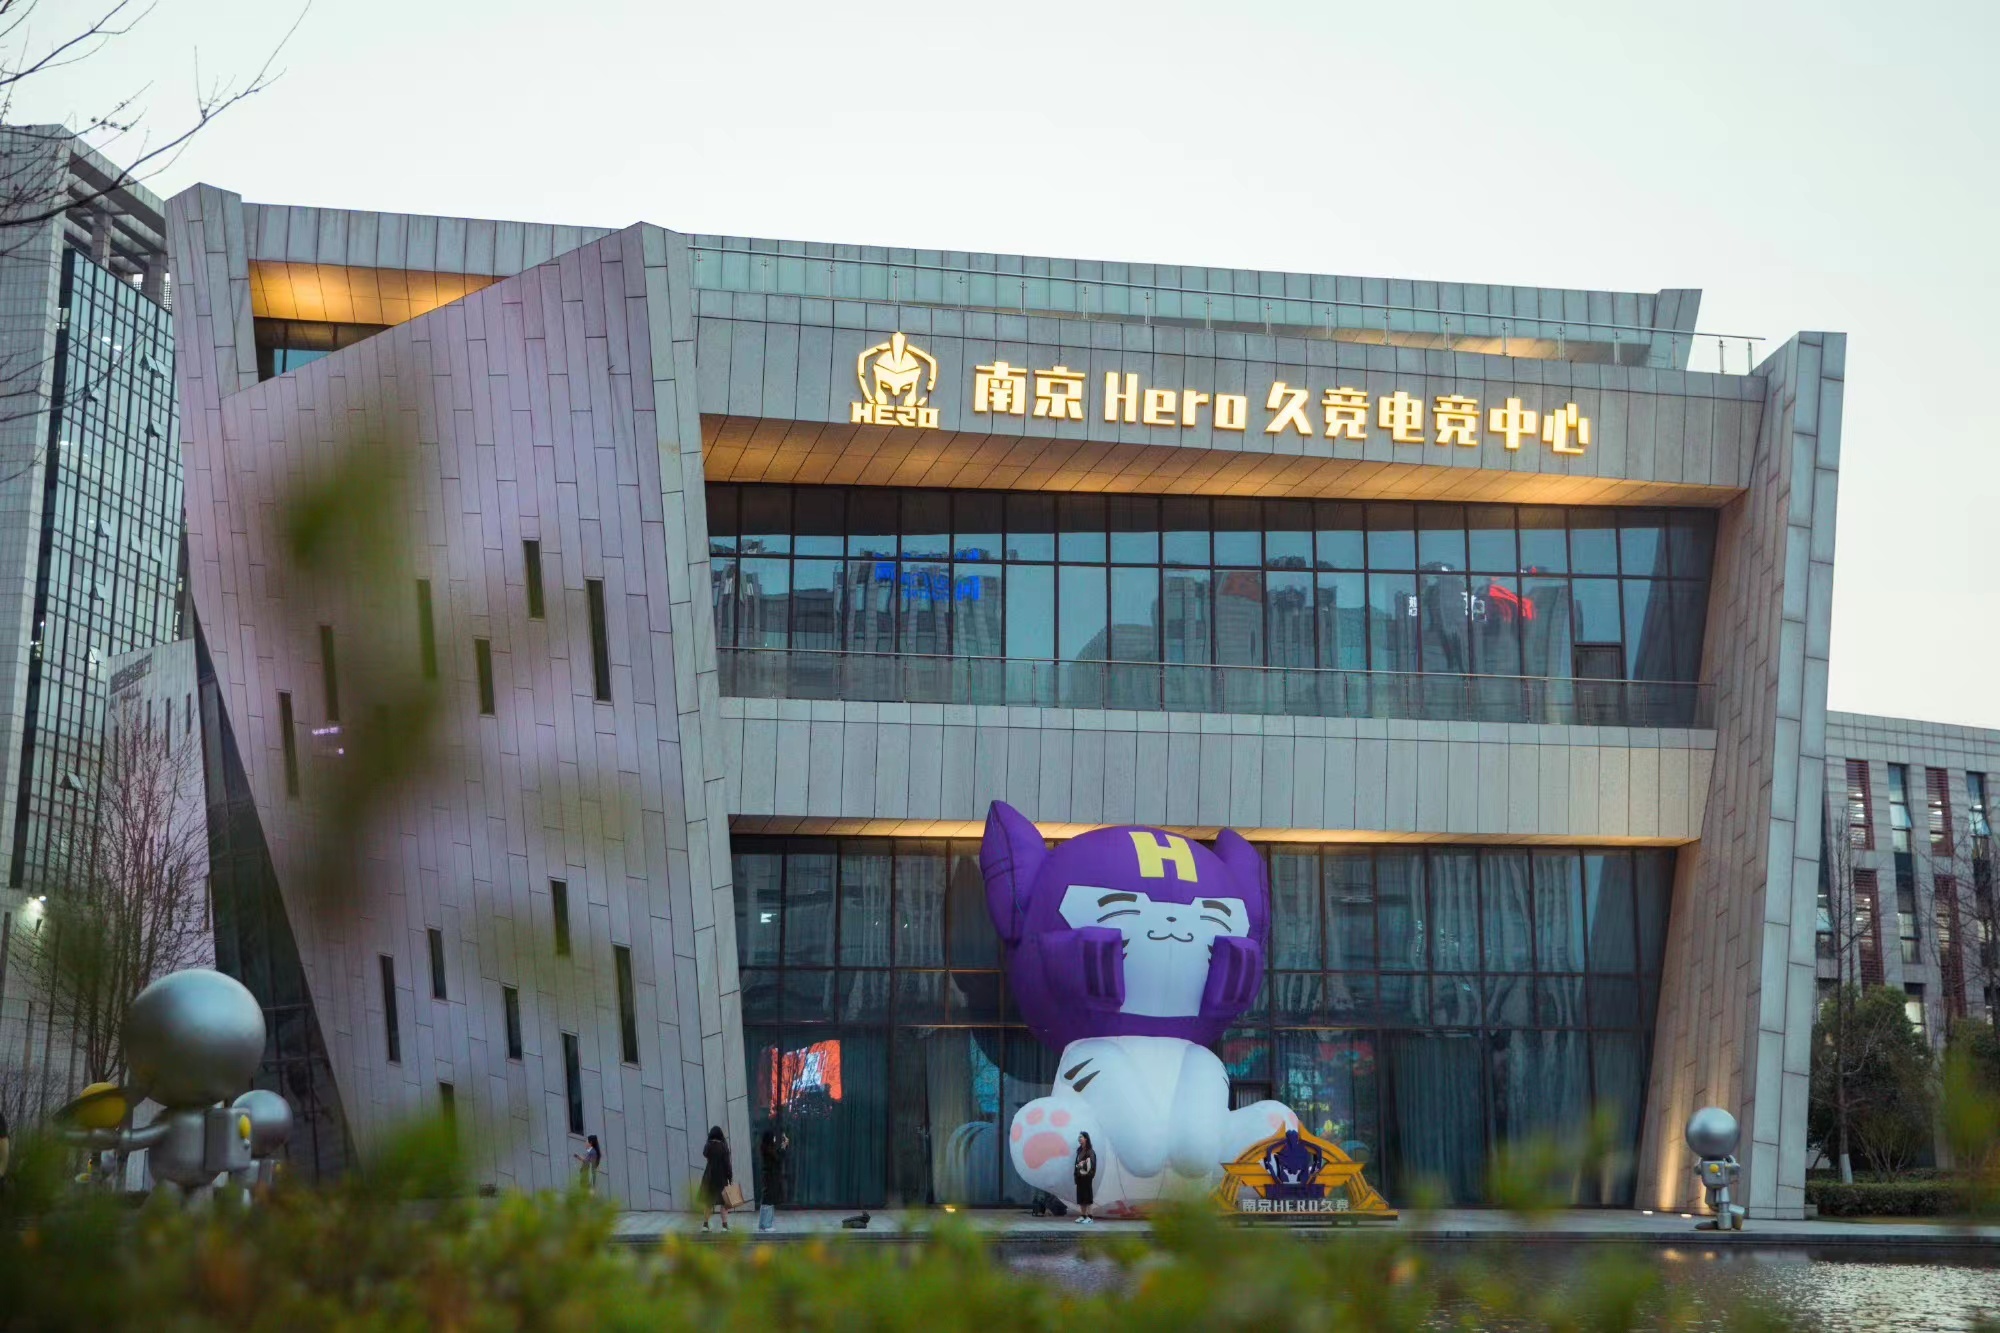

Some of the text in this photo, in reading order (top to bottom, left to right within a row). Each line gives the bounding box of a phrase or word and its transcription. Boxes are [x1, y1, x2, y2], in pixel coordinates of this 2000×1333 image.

[850, 401, 940, 429] HERO
[973, 360, 1591, 455] 南京 Hero 久竞电竞中心
[1128, 831, 1198, 883] H
